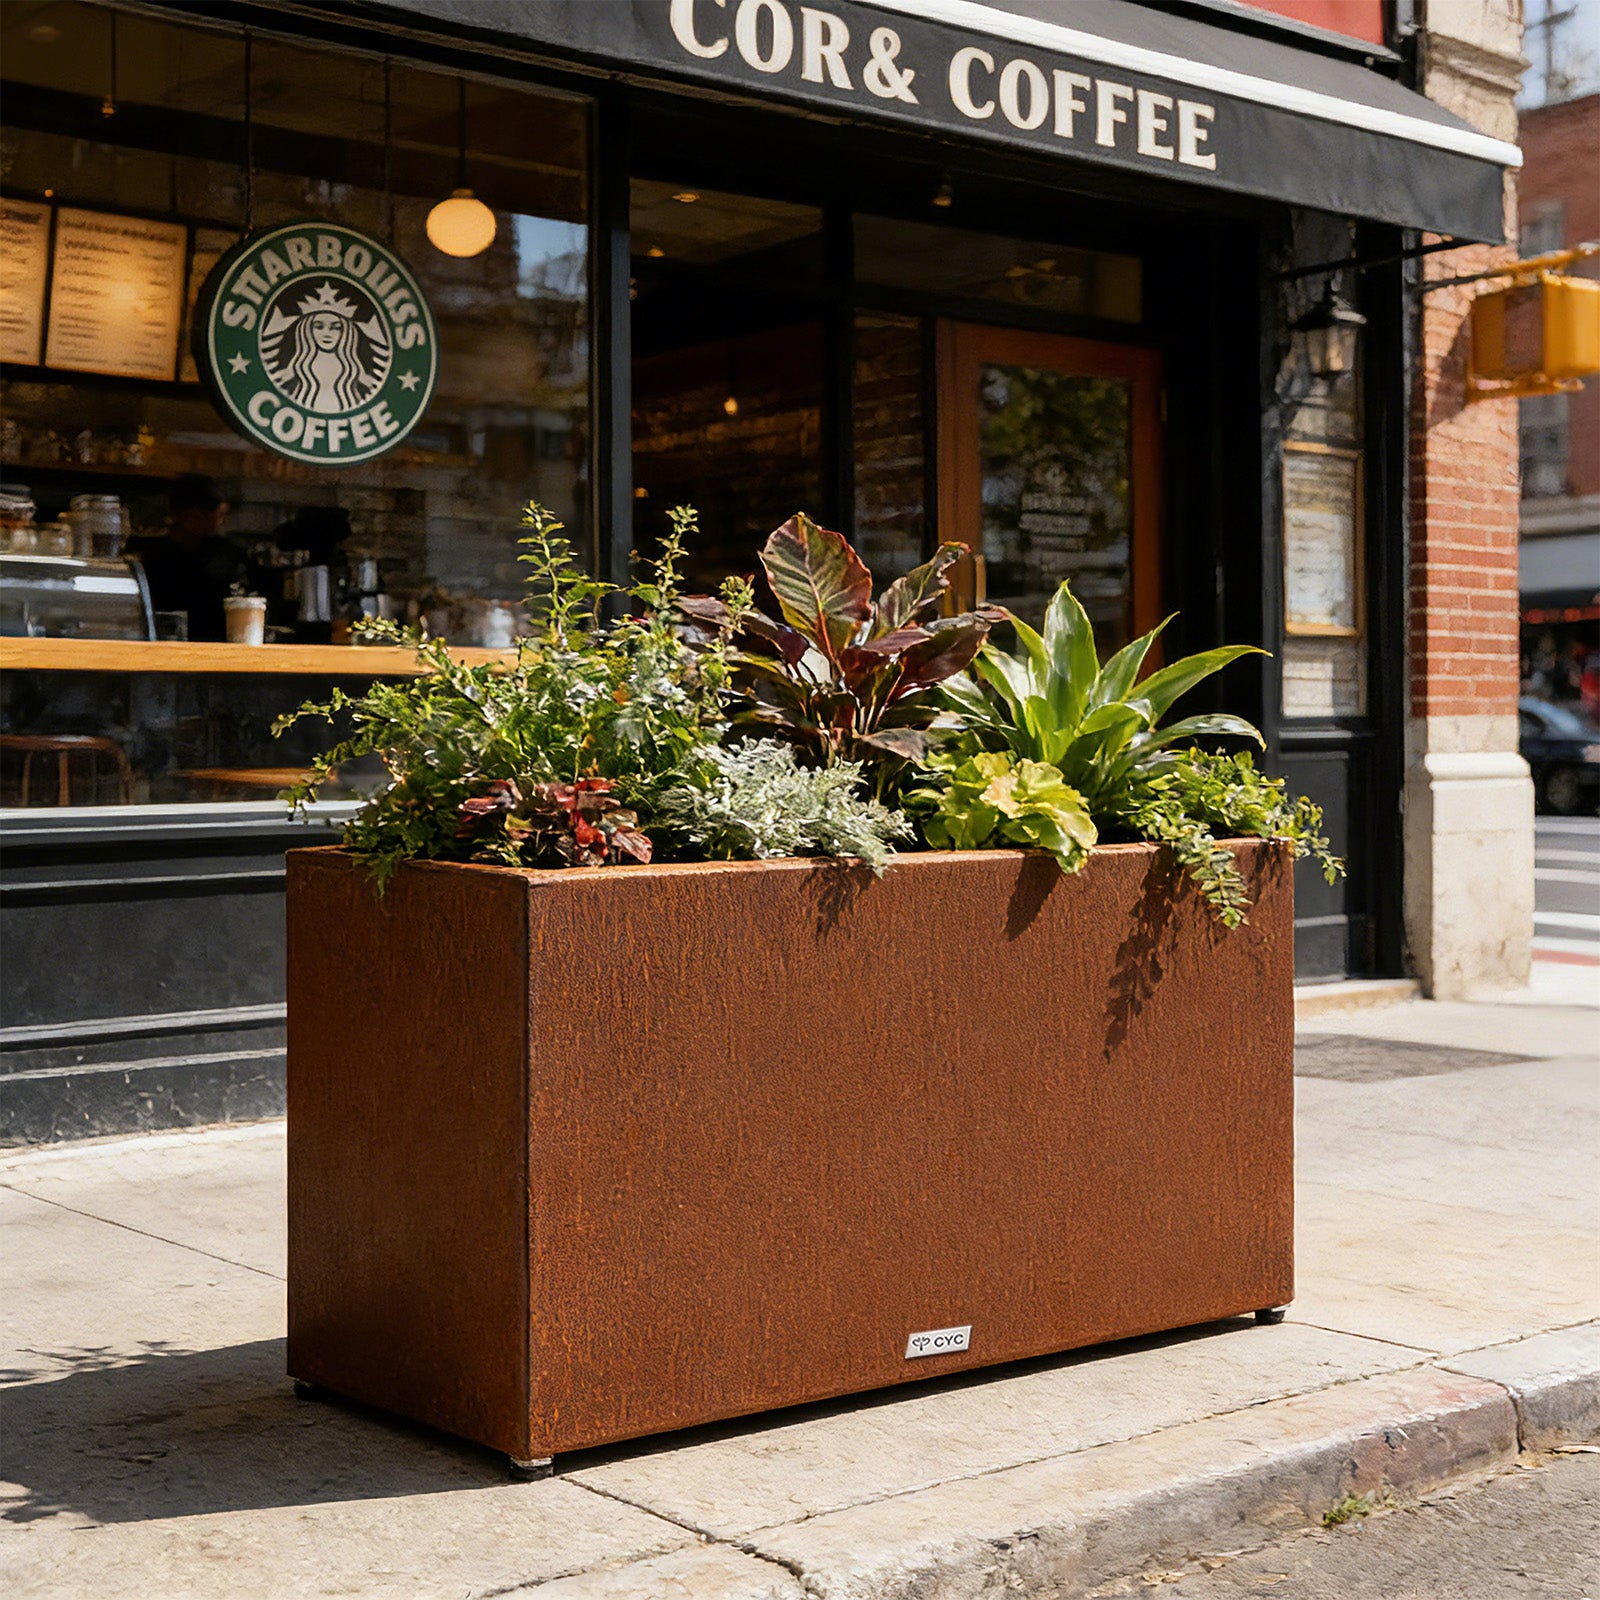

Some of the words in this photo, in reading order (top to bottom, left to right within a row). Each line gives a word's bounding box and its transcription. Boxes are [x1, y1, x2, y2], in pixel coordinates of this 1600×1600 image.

[948, 46, 1217, 171] COFFEE
[247, 390, 400, 453] COFFEE
[934, 1333, 964, 1348] CYC
